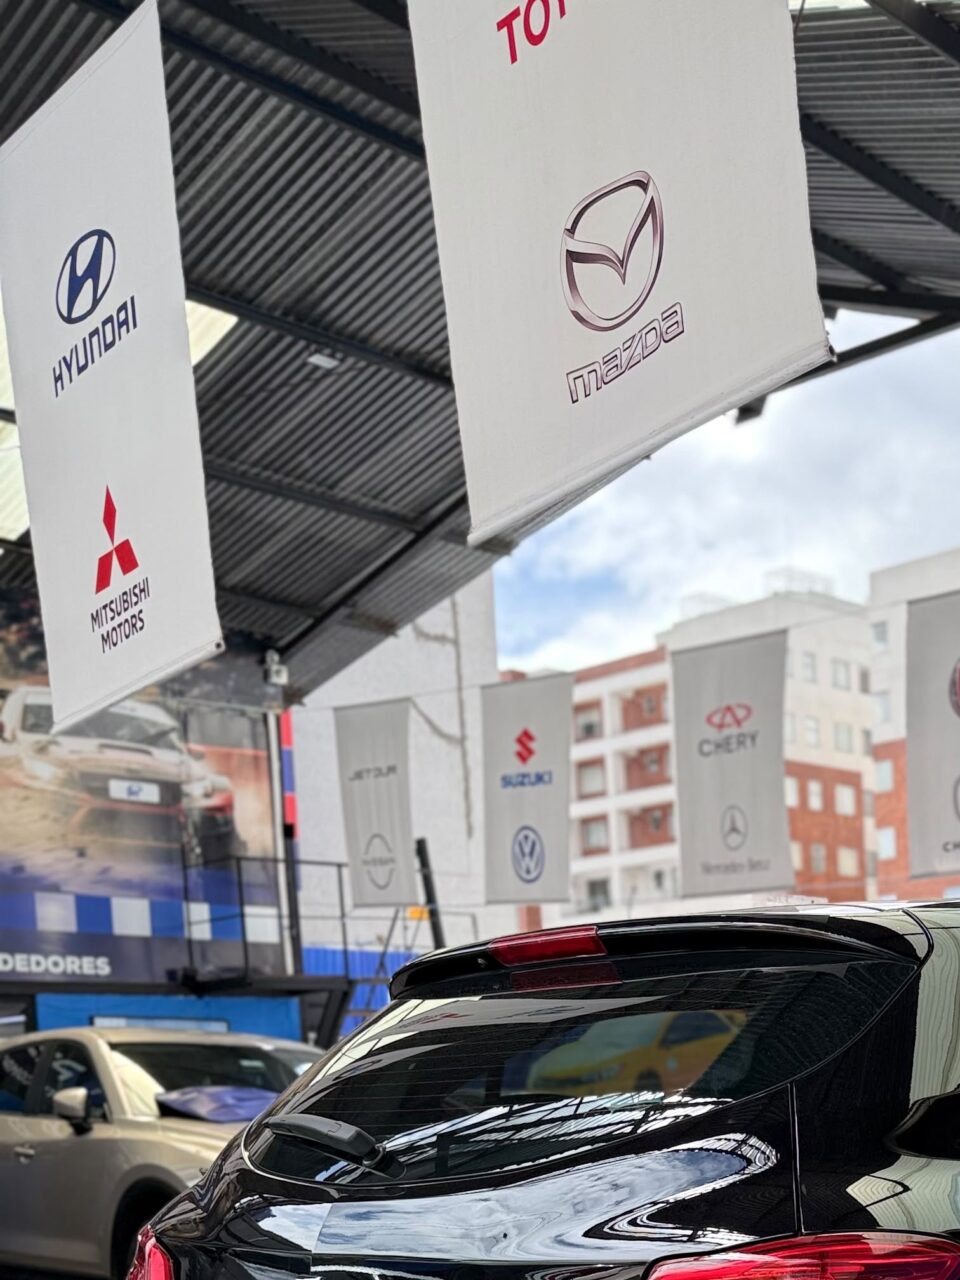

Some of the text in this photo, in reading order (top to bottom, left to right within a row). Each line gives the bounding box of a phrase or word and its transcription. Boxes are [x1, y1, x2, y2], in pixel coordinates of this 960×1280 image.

[52, 294, 138, 399] HYUNDAI
[566, 301, 685, 404] mazda
[90, 576, 150, 633] MITSUBISHI
[101, 608, 145, 654] MOTORS
[697, 730, 759, 757] CHERY
[501, 770, 553, 789] SUZUKI
[0, 951, 112, 976] DEDORES
